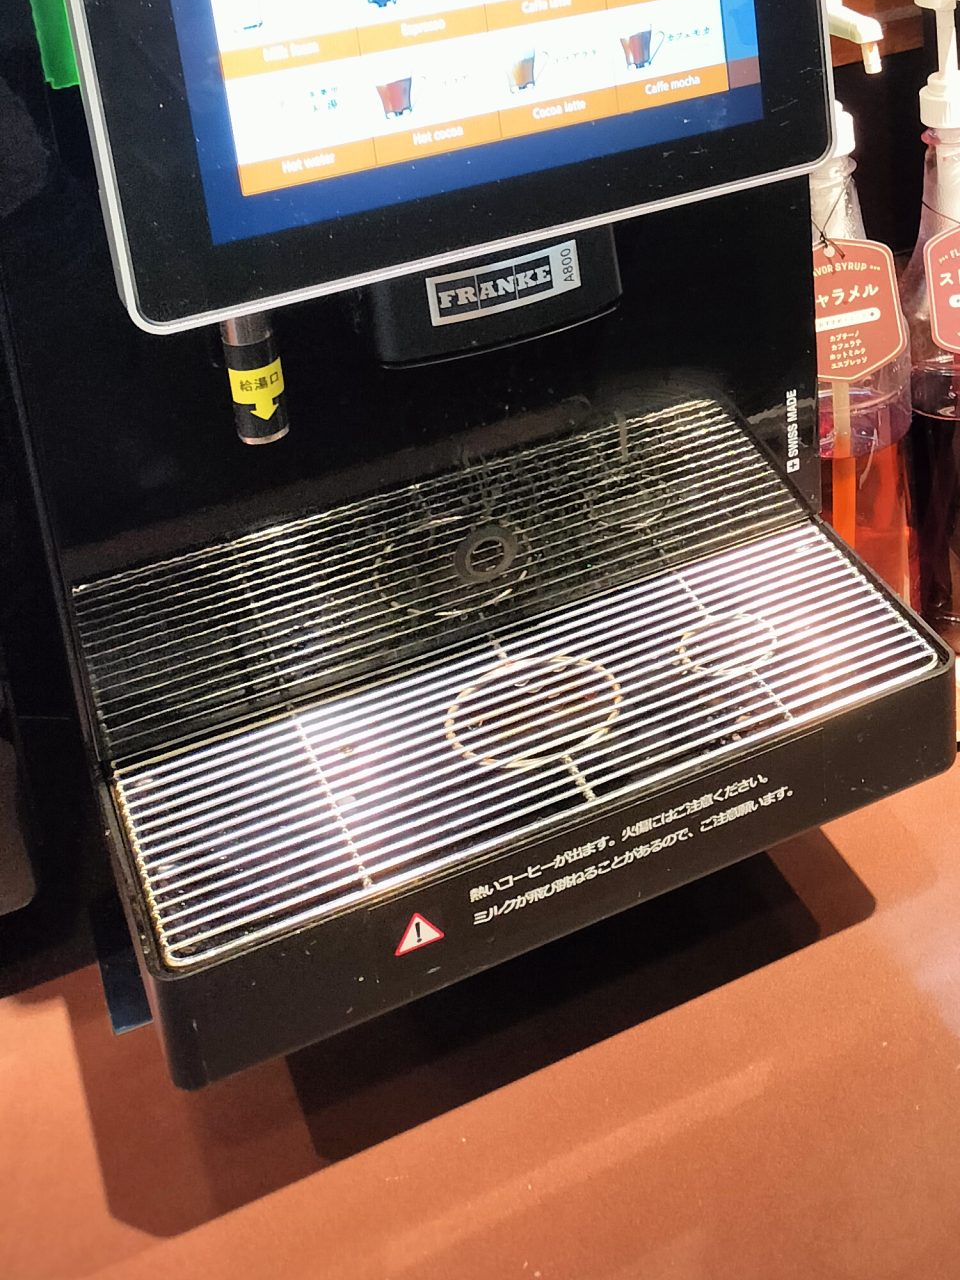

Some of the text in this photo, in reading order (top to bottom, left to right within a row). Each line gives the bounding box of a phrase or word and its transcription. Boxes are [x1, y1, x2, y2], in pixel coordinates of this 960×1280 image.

[645, 75, 700, 95] Caffe mocha
[834, 261, 867, 272] SYRUP
[438, 248, 575, 308] FRANKE A800
[829, 330, 860, 343] カプチーノ
[831, 338, 862, 351] カフェラテ
[829, 347, 866, 361] ホットミルク
[830, 356, 868, 369] エスプレッソ
[240, 372, 279, 392] 給湯口
[786, 388, 799, 458] SWISS MADE
[469, 773, 769, 902] 熱いコーヒーが出ます。火傷にはご注意ください。
[473, 785, 794, 925] ミルクが飛び跳ねることがあるので、ご注意願います。
